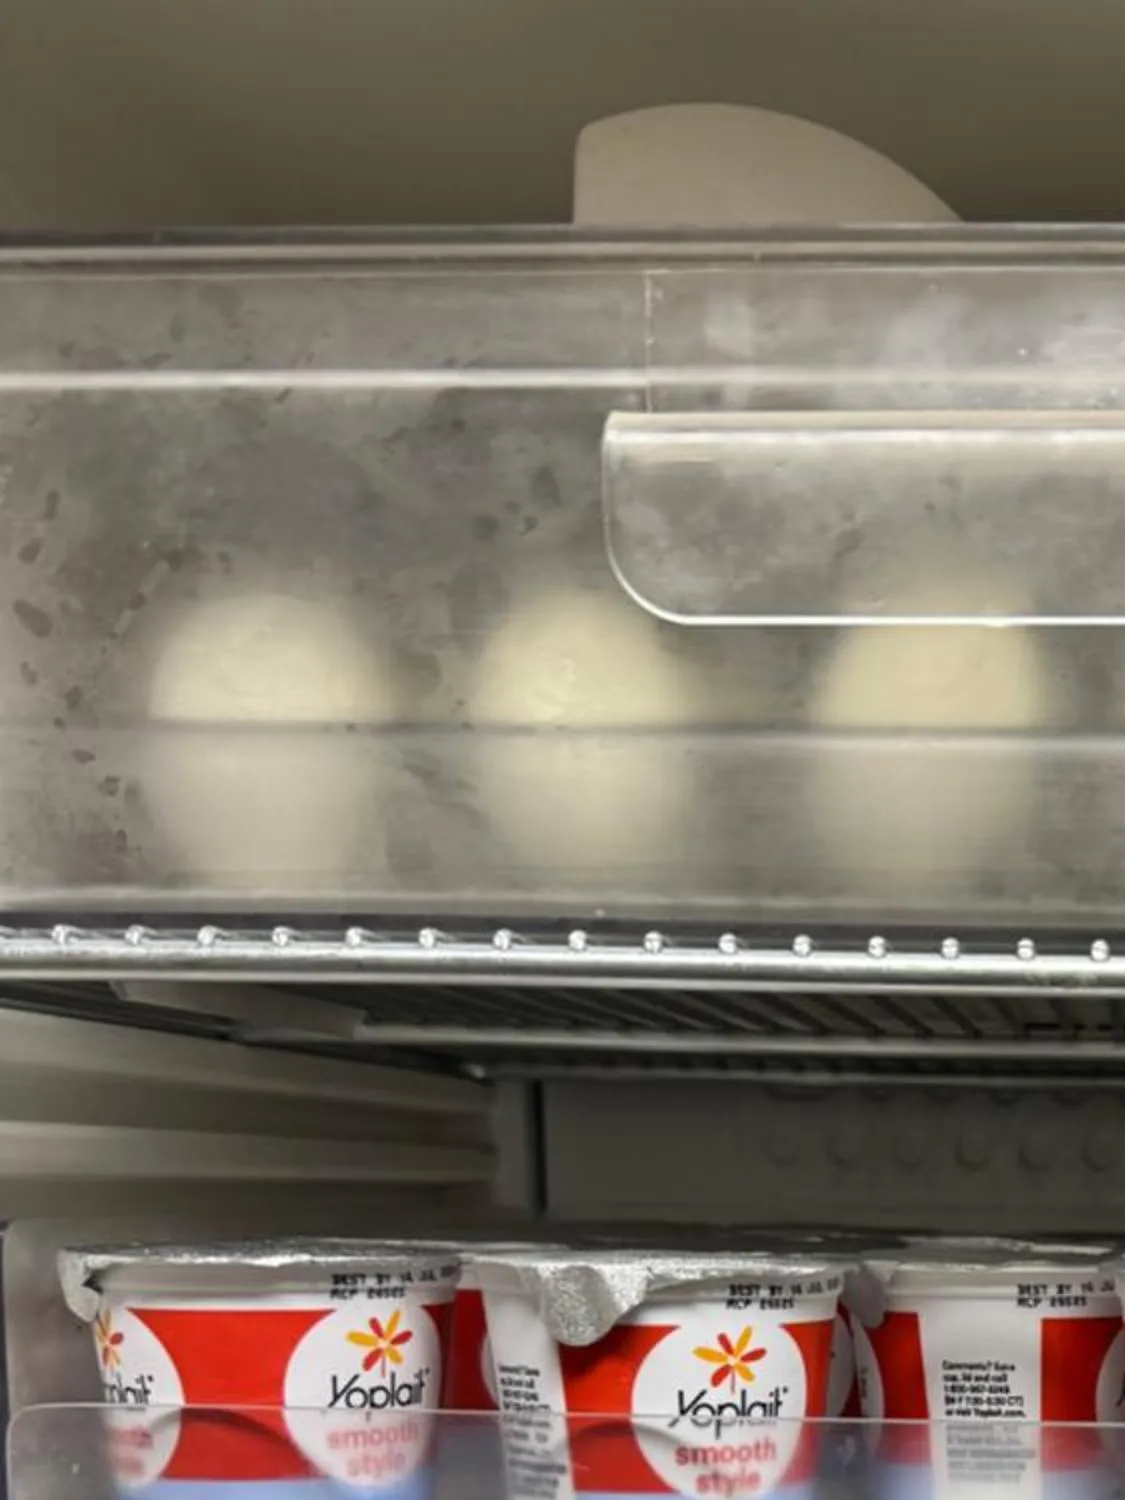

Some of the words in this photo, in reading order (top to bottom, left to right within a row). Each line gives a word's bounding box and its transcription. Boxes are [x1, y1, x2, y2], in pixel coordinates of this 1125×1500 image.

[327, 1369, 425, 1421] Yoplait
[668, 1387, 784, 1440] Yoplait
[675, 1438, 777, 1467] smooth
[695, 1469, 762, 1497] style
